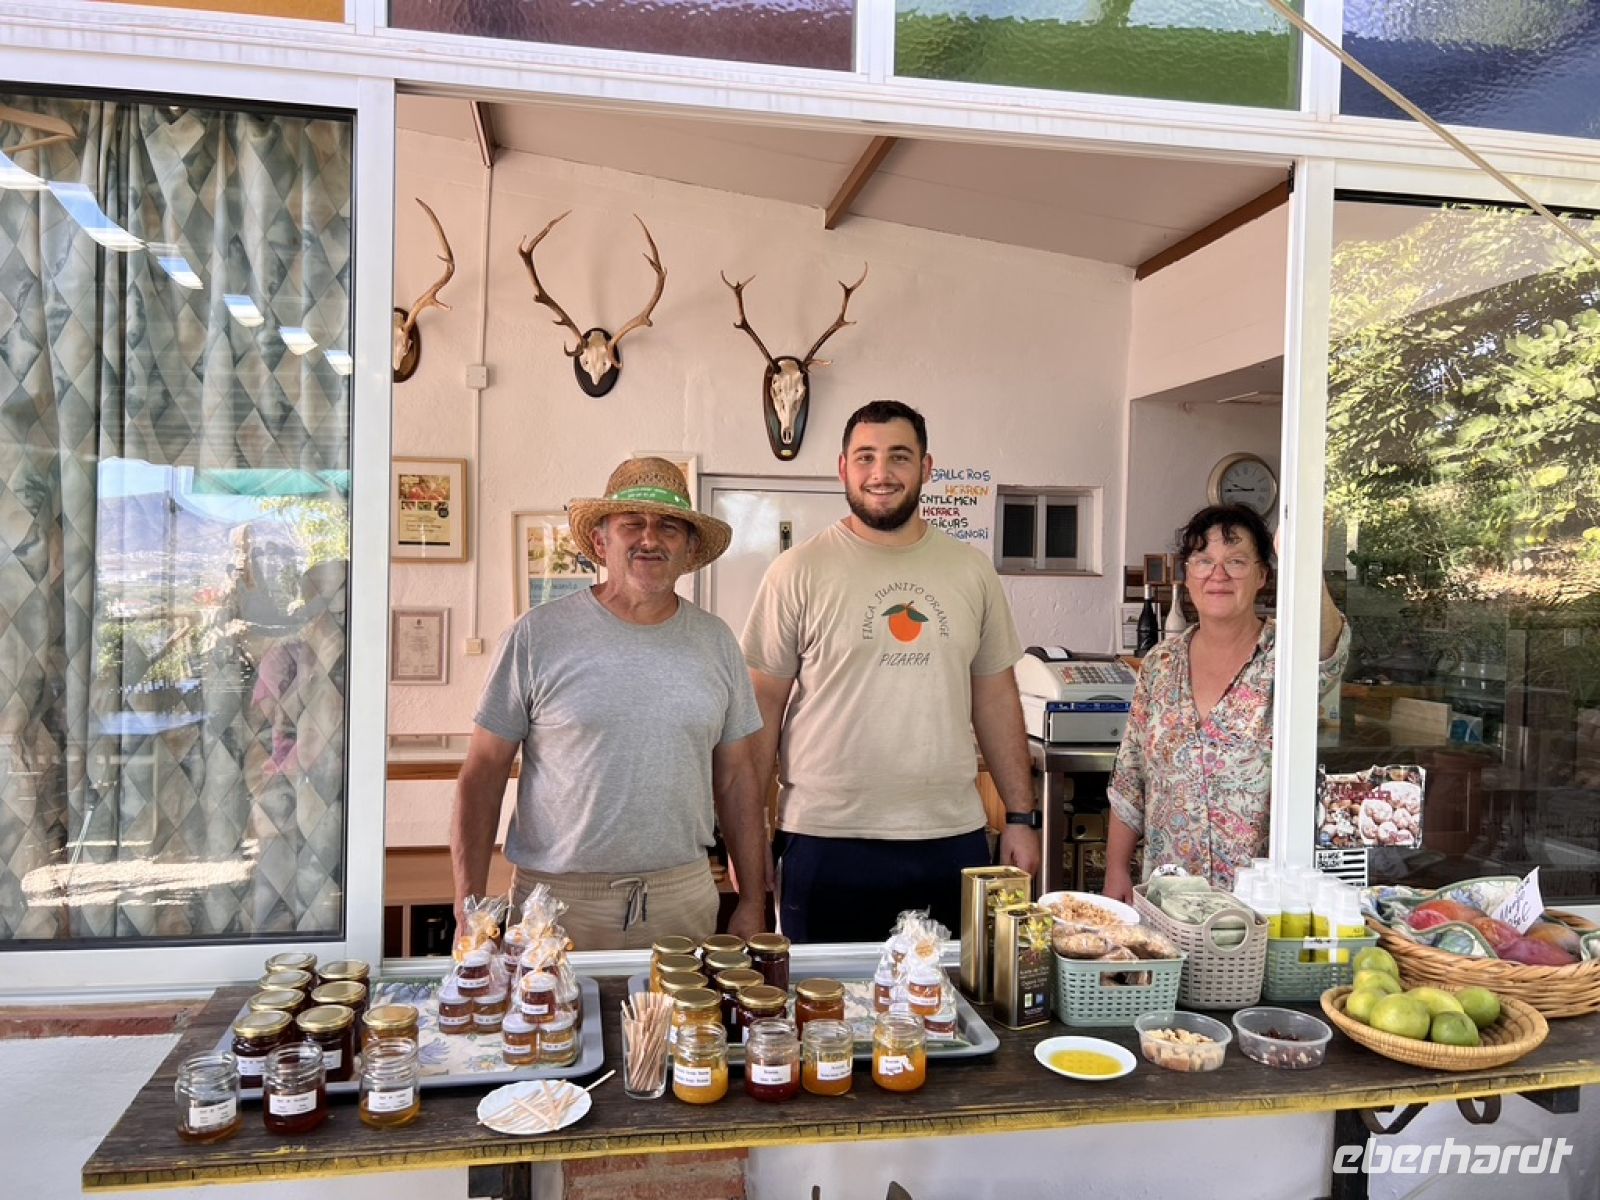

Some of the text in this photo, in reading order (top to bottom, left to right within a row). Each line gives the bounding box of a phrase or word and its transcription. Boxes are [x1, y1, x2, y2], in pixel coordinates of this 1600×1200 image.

[945, 484, 990, 496] HERREN
[862, 582, 950, 640] FINCA JUANITO ORANGE
[879, 652, 931, 667] PIZARRA
